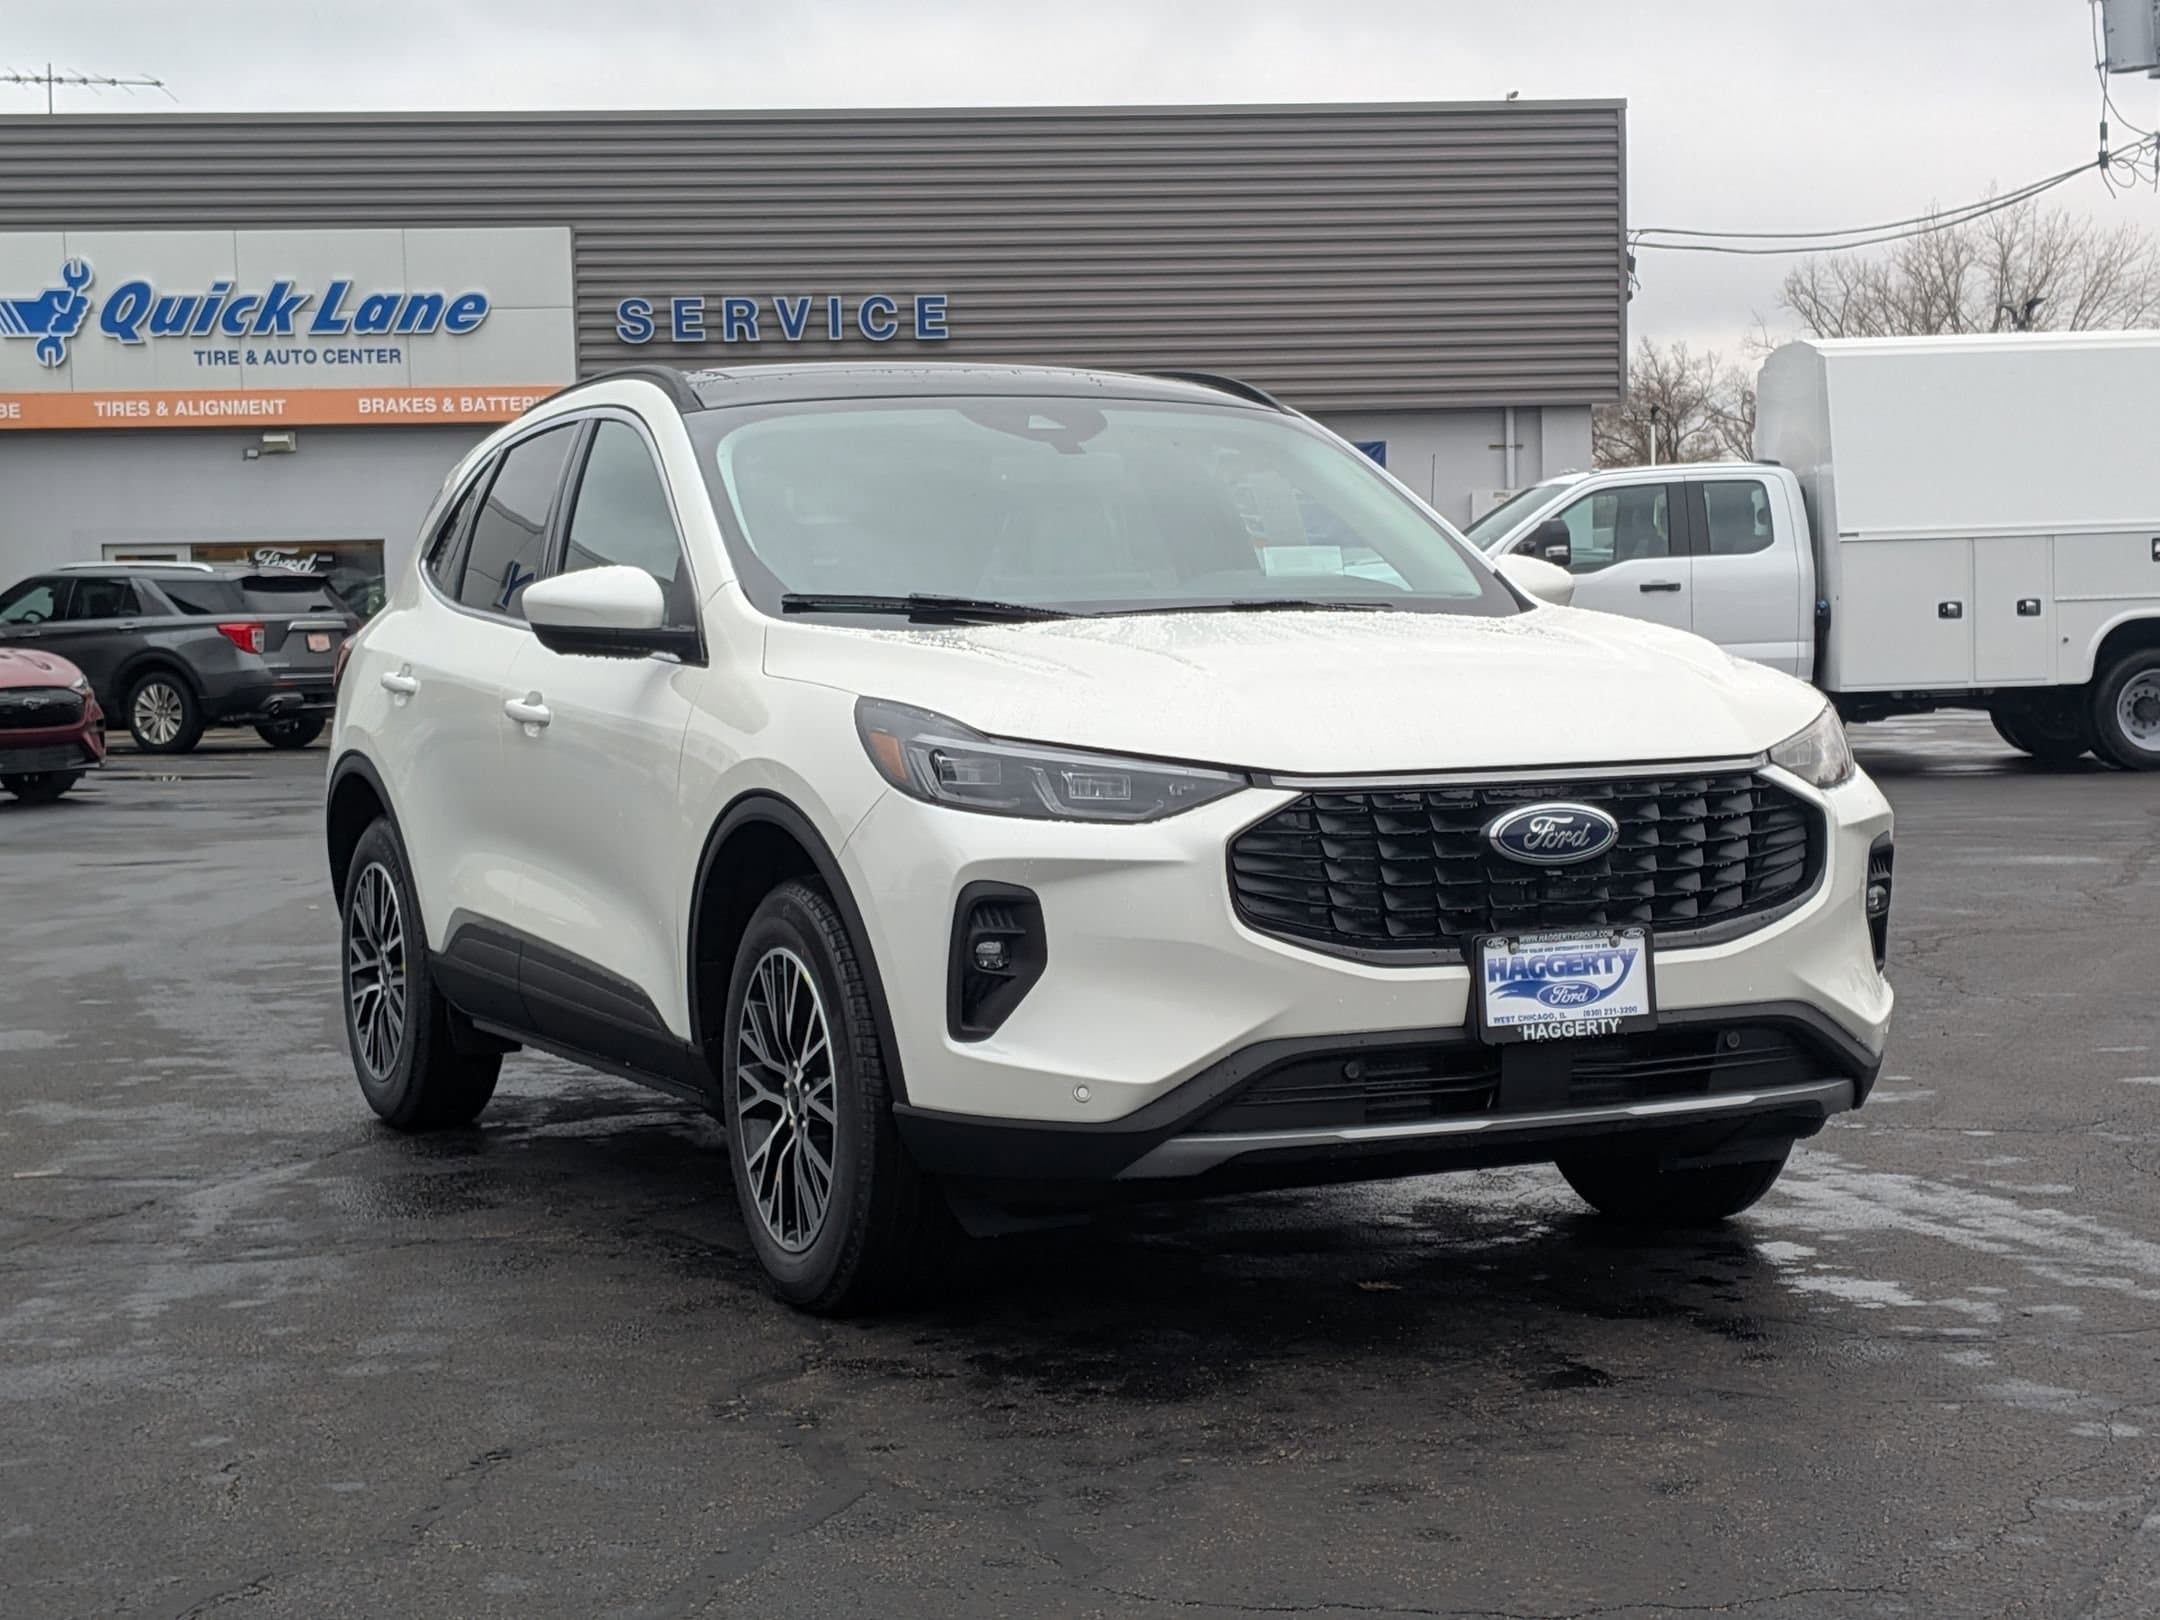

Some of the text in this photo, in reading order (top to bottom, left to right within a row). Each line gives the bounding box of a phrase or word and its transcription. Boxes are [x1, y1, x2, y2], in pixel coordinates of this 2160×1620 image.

[100, 279, 491, 344] Quick Lane
[616, 294, 949, 344] SERVICE
[194, 348, 402, 366] TIRE & AUTO CENTER
[94, 399, 286, 417] TIRES & ALIGNMENT
[358, 397, 437, 414] BRAKES
[442, 397, 455, 413] &
[254, 546, 317, 574] Ford
[1523, 816, 1592, 849] Ford
[1487, 948, 1639, 984] HAGGERTY
[1549, 984, 1588, 1004] Ford
[1493, 1015, 1515, 1025] WEST
[1522, 1018, 1620, 1041] HAGGERTY
